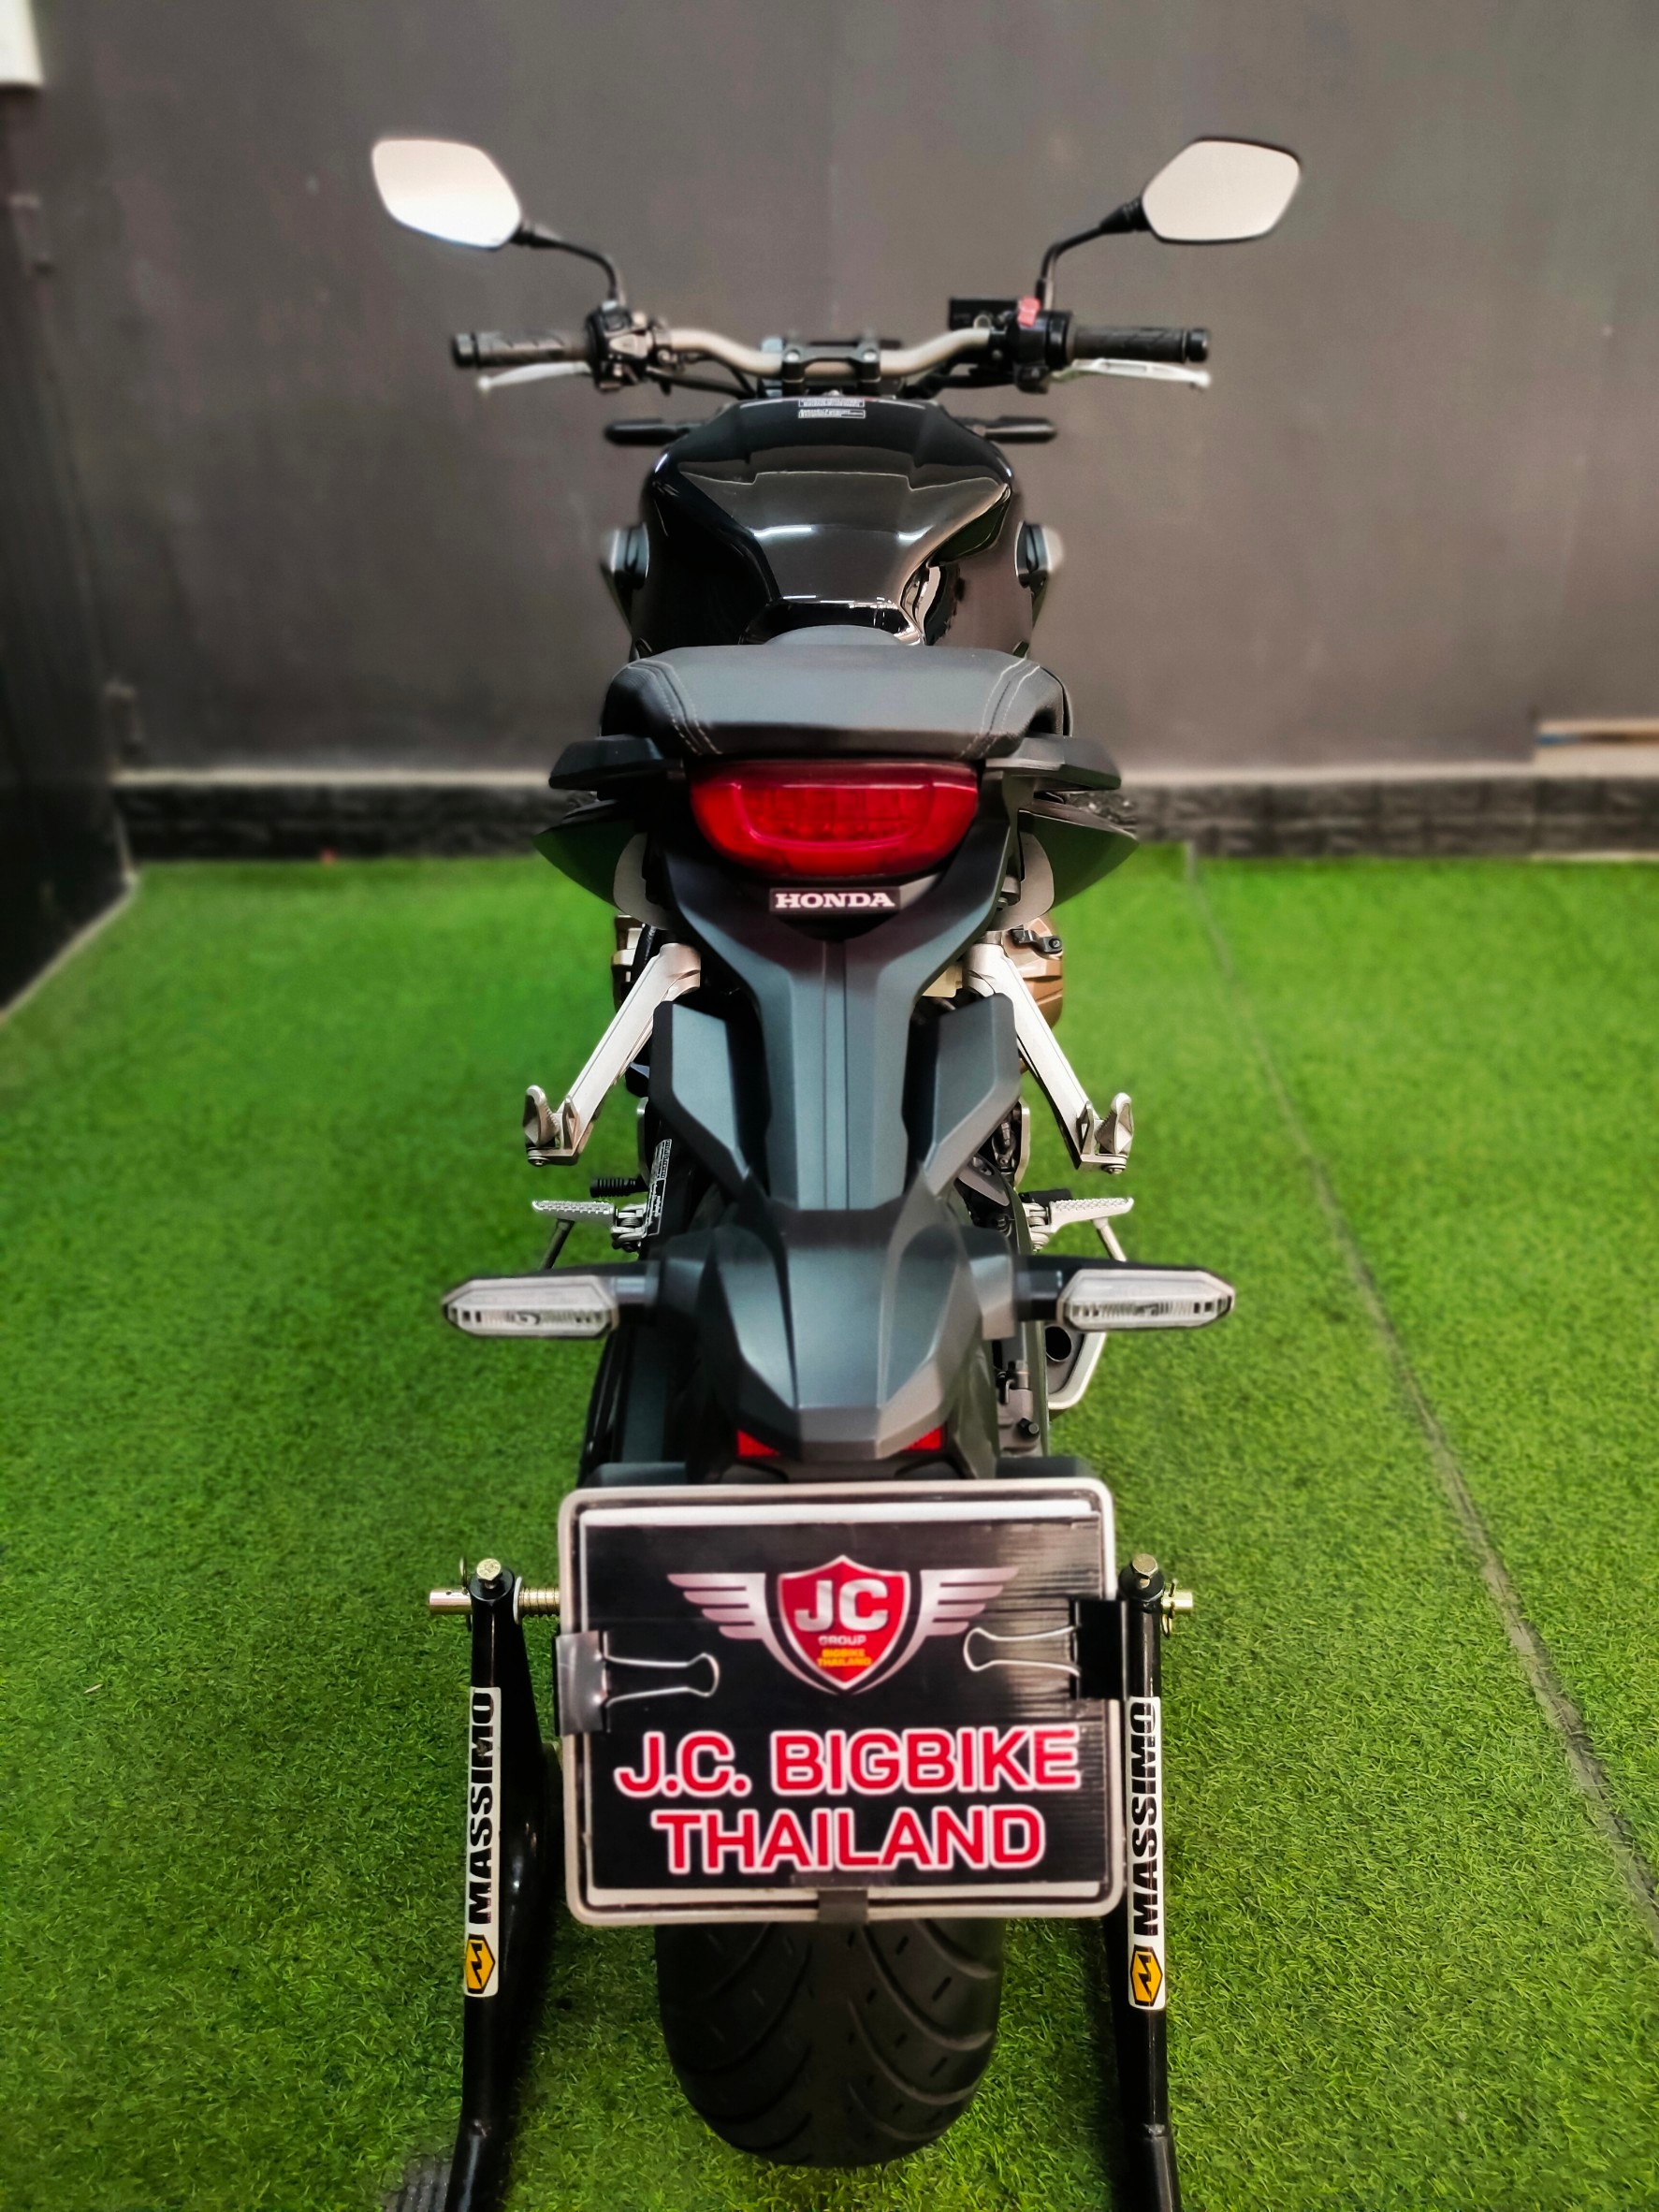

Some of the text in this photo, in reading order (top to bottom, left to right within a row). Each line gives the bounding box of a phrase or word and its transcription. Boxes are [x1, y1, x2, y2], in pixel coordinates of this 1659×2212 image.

[775, 893, 895, 909] HONDA
[794, 1579, 888, 1631] JC
[818, 1635, 866, 1646] GROUP
[614, 1724, 1081, 1797] J.C. BIGBIKE
[469, 1692, 495, 1925] MASSIMO
[652, 1804, 1046, 1874] THAILAND
[1129, 1701, 1158, 1937] MASSIMO
